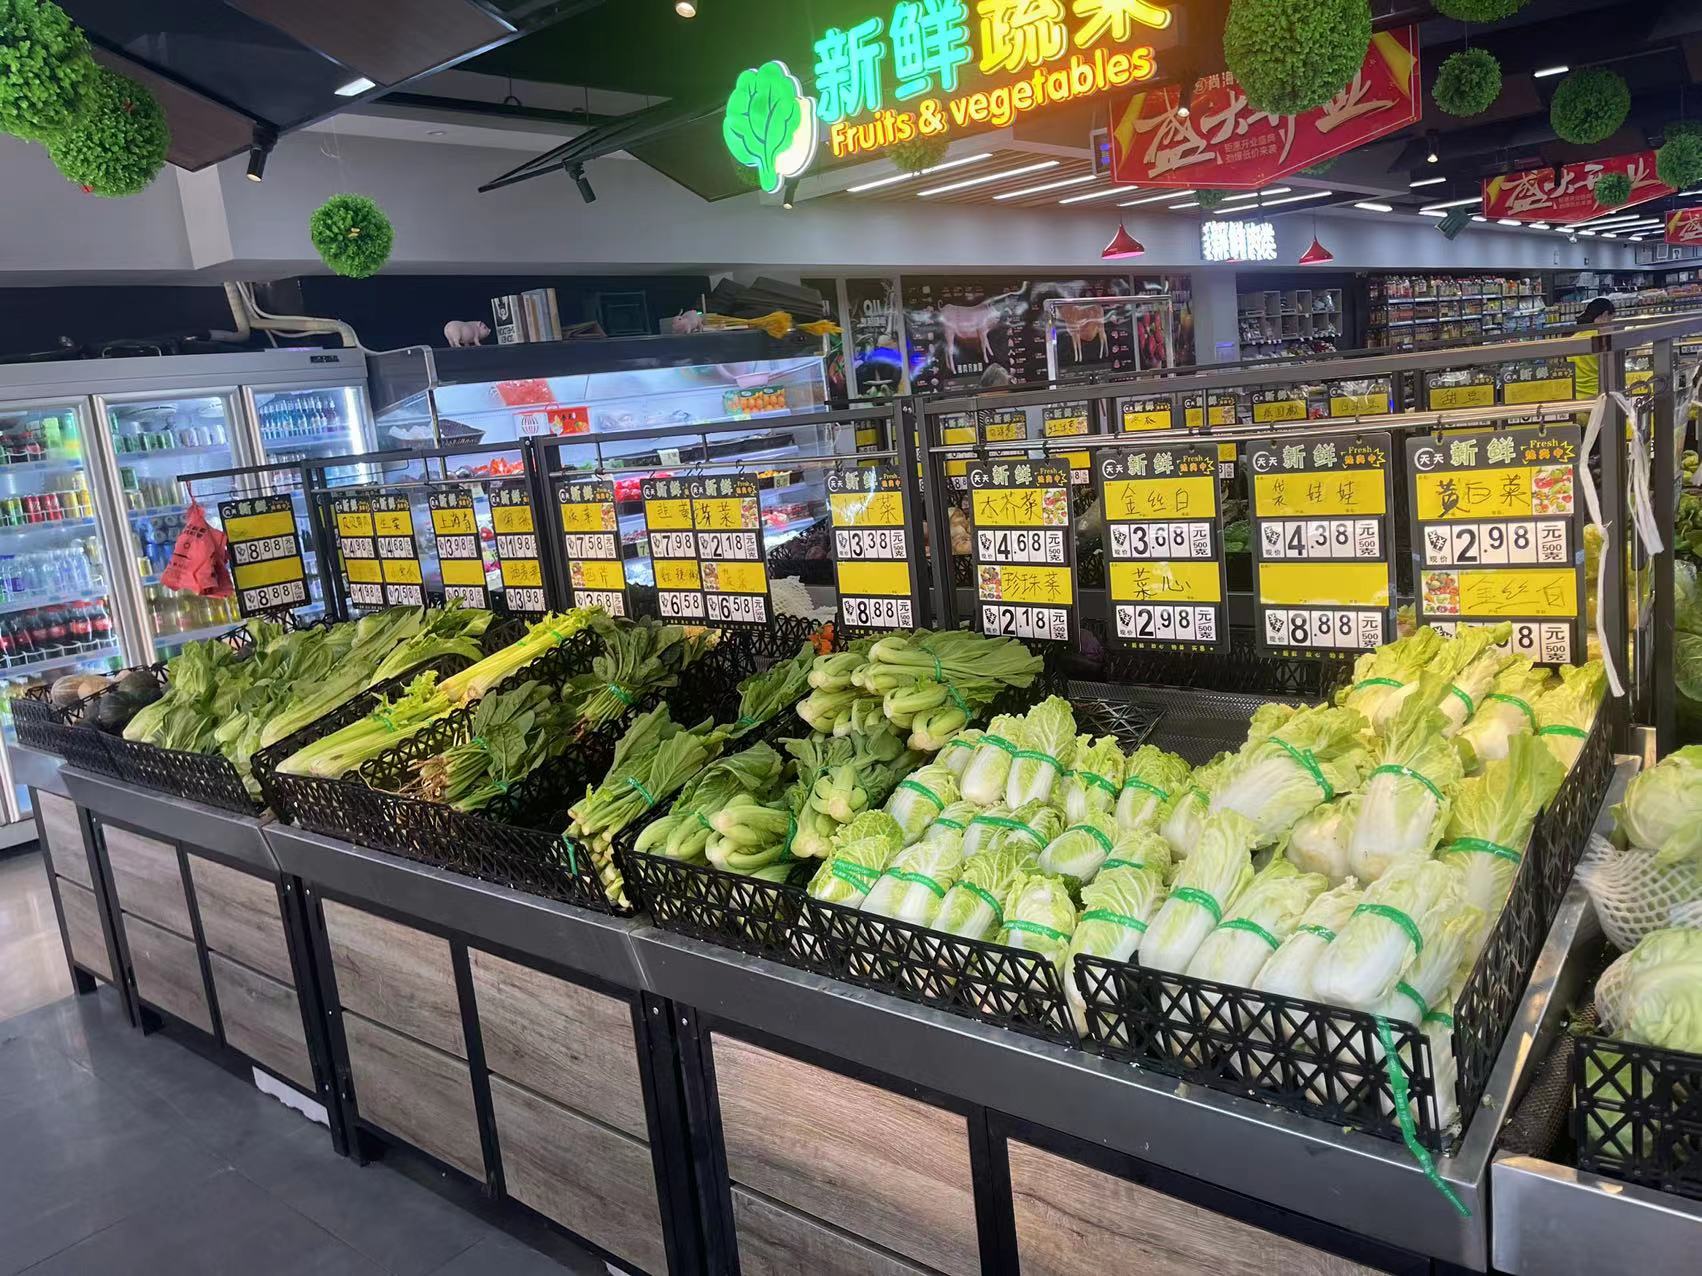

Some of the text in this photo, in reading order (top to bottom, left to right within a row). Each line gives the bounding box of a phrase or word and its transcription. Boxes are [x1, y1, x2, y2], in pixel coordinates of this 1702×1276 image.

[830, 46, 1158, 157] Fruits & vegetables
[1419, 437, 1516, 466] 天天 新鲜
[1530, 438, 1559, 449] Fresh
[1127, 452, 1174, 476] 新鲜
[1257, 443, 1337, 470] 天天 新鲜
[845, 471, 878, 490] 新鲜
[992, 465, 1033, 485] 新鲜
[705, 479, 732, 496] 新鲜
[1121, 483, 1190, 515] 金丝白
[250, 539, 281, 560] 8.88
[662, 535, 691, 556] 7.98
[712, 535, 743, 557] 2.18
[852, 532, 887, 557] 3.38
[997, 533, 1041, 560] 4.68
[1132, 526, 1185, 555] 3.68
[1287, 523, 1349, 557] 4.38
[1455, 525, 1530, 563] 2.98
[258, 585, 290, 606] 8.88
[671, 595, 699, 614] 6.58
[720, 596, 751, 619] 6.58
[858, 600, 894, 624] 8.88
[1002, 608, 1046, 636] 2.18
[1138, 608, 1190, 637] 2.98
[1290, 613, 1352, 644] 8.88
